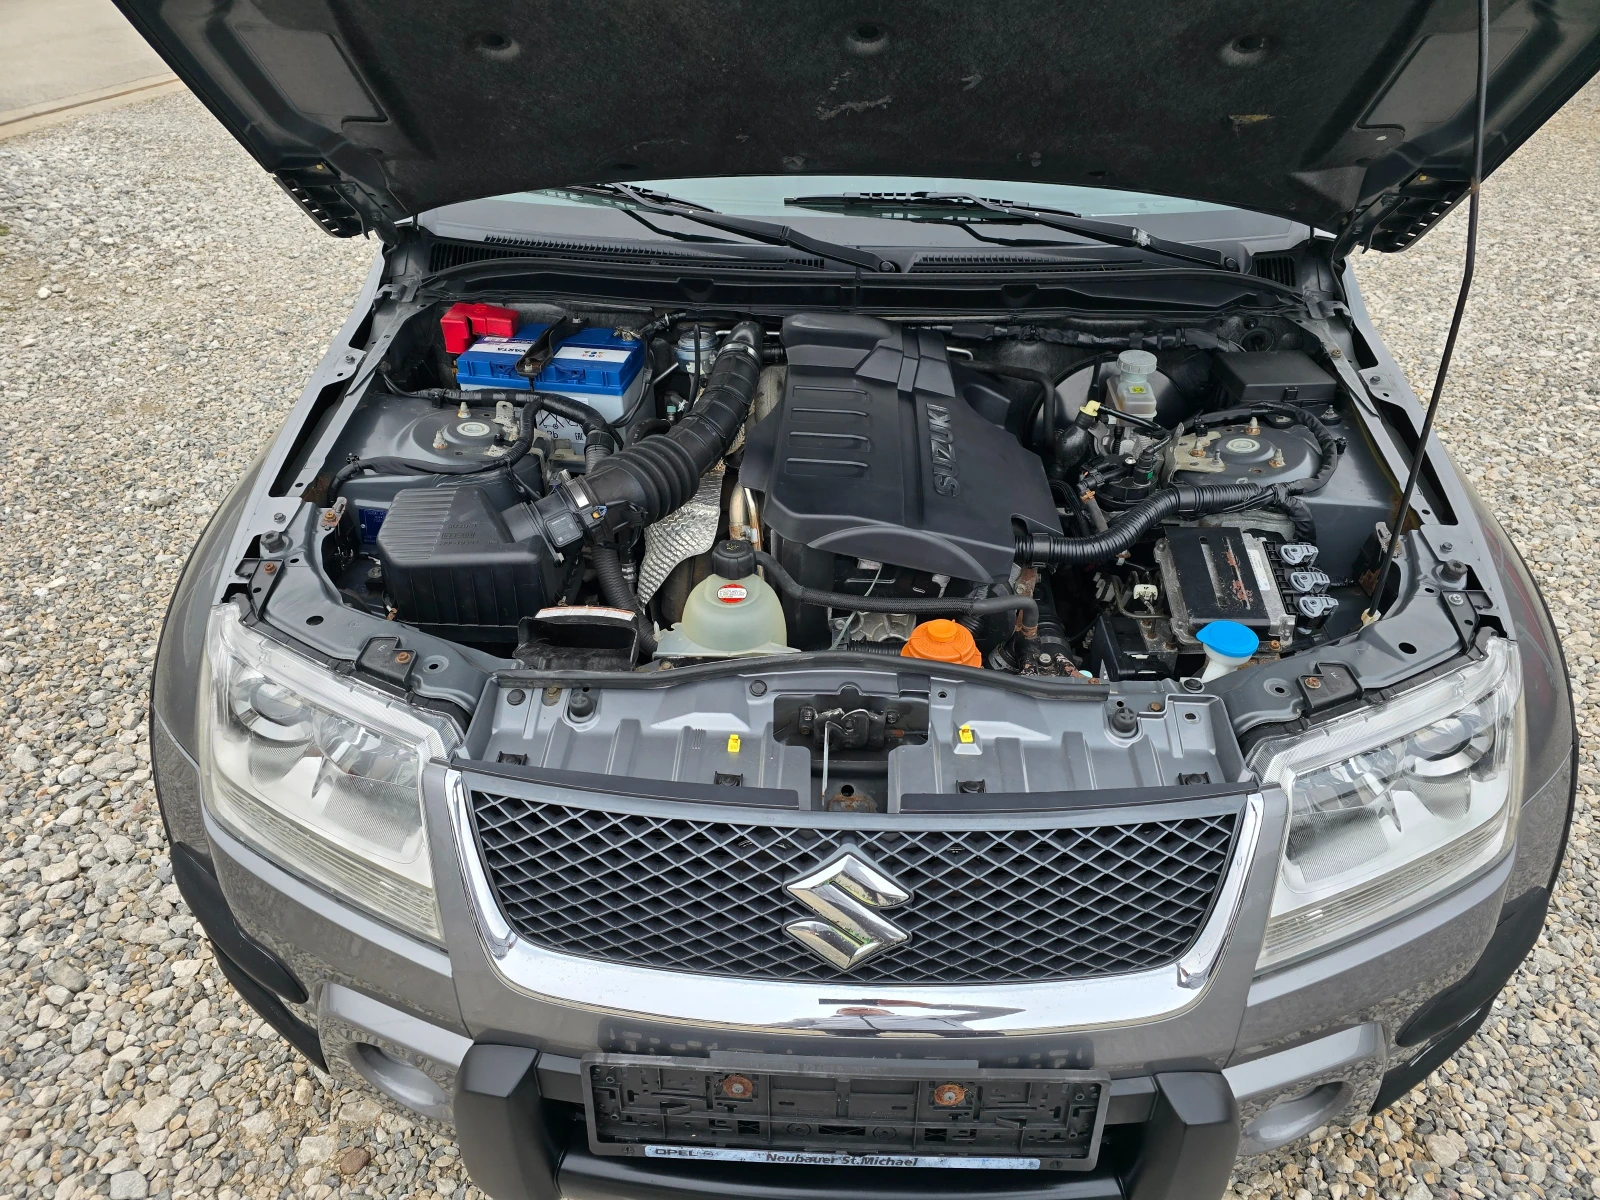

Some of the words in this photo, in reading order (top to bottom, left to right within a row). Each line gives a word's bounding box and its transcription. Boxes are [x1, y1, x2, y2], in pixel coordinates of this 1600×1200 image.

[926, 403, 961, 497] SUZUKI
[655, 1148, 699, 1157] OPEL
[765, 1153, 839, 1165] Neubauer
